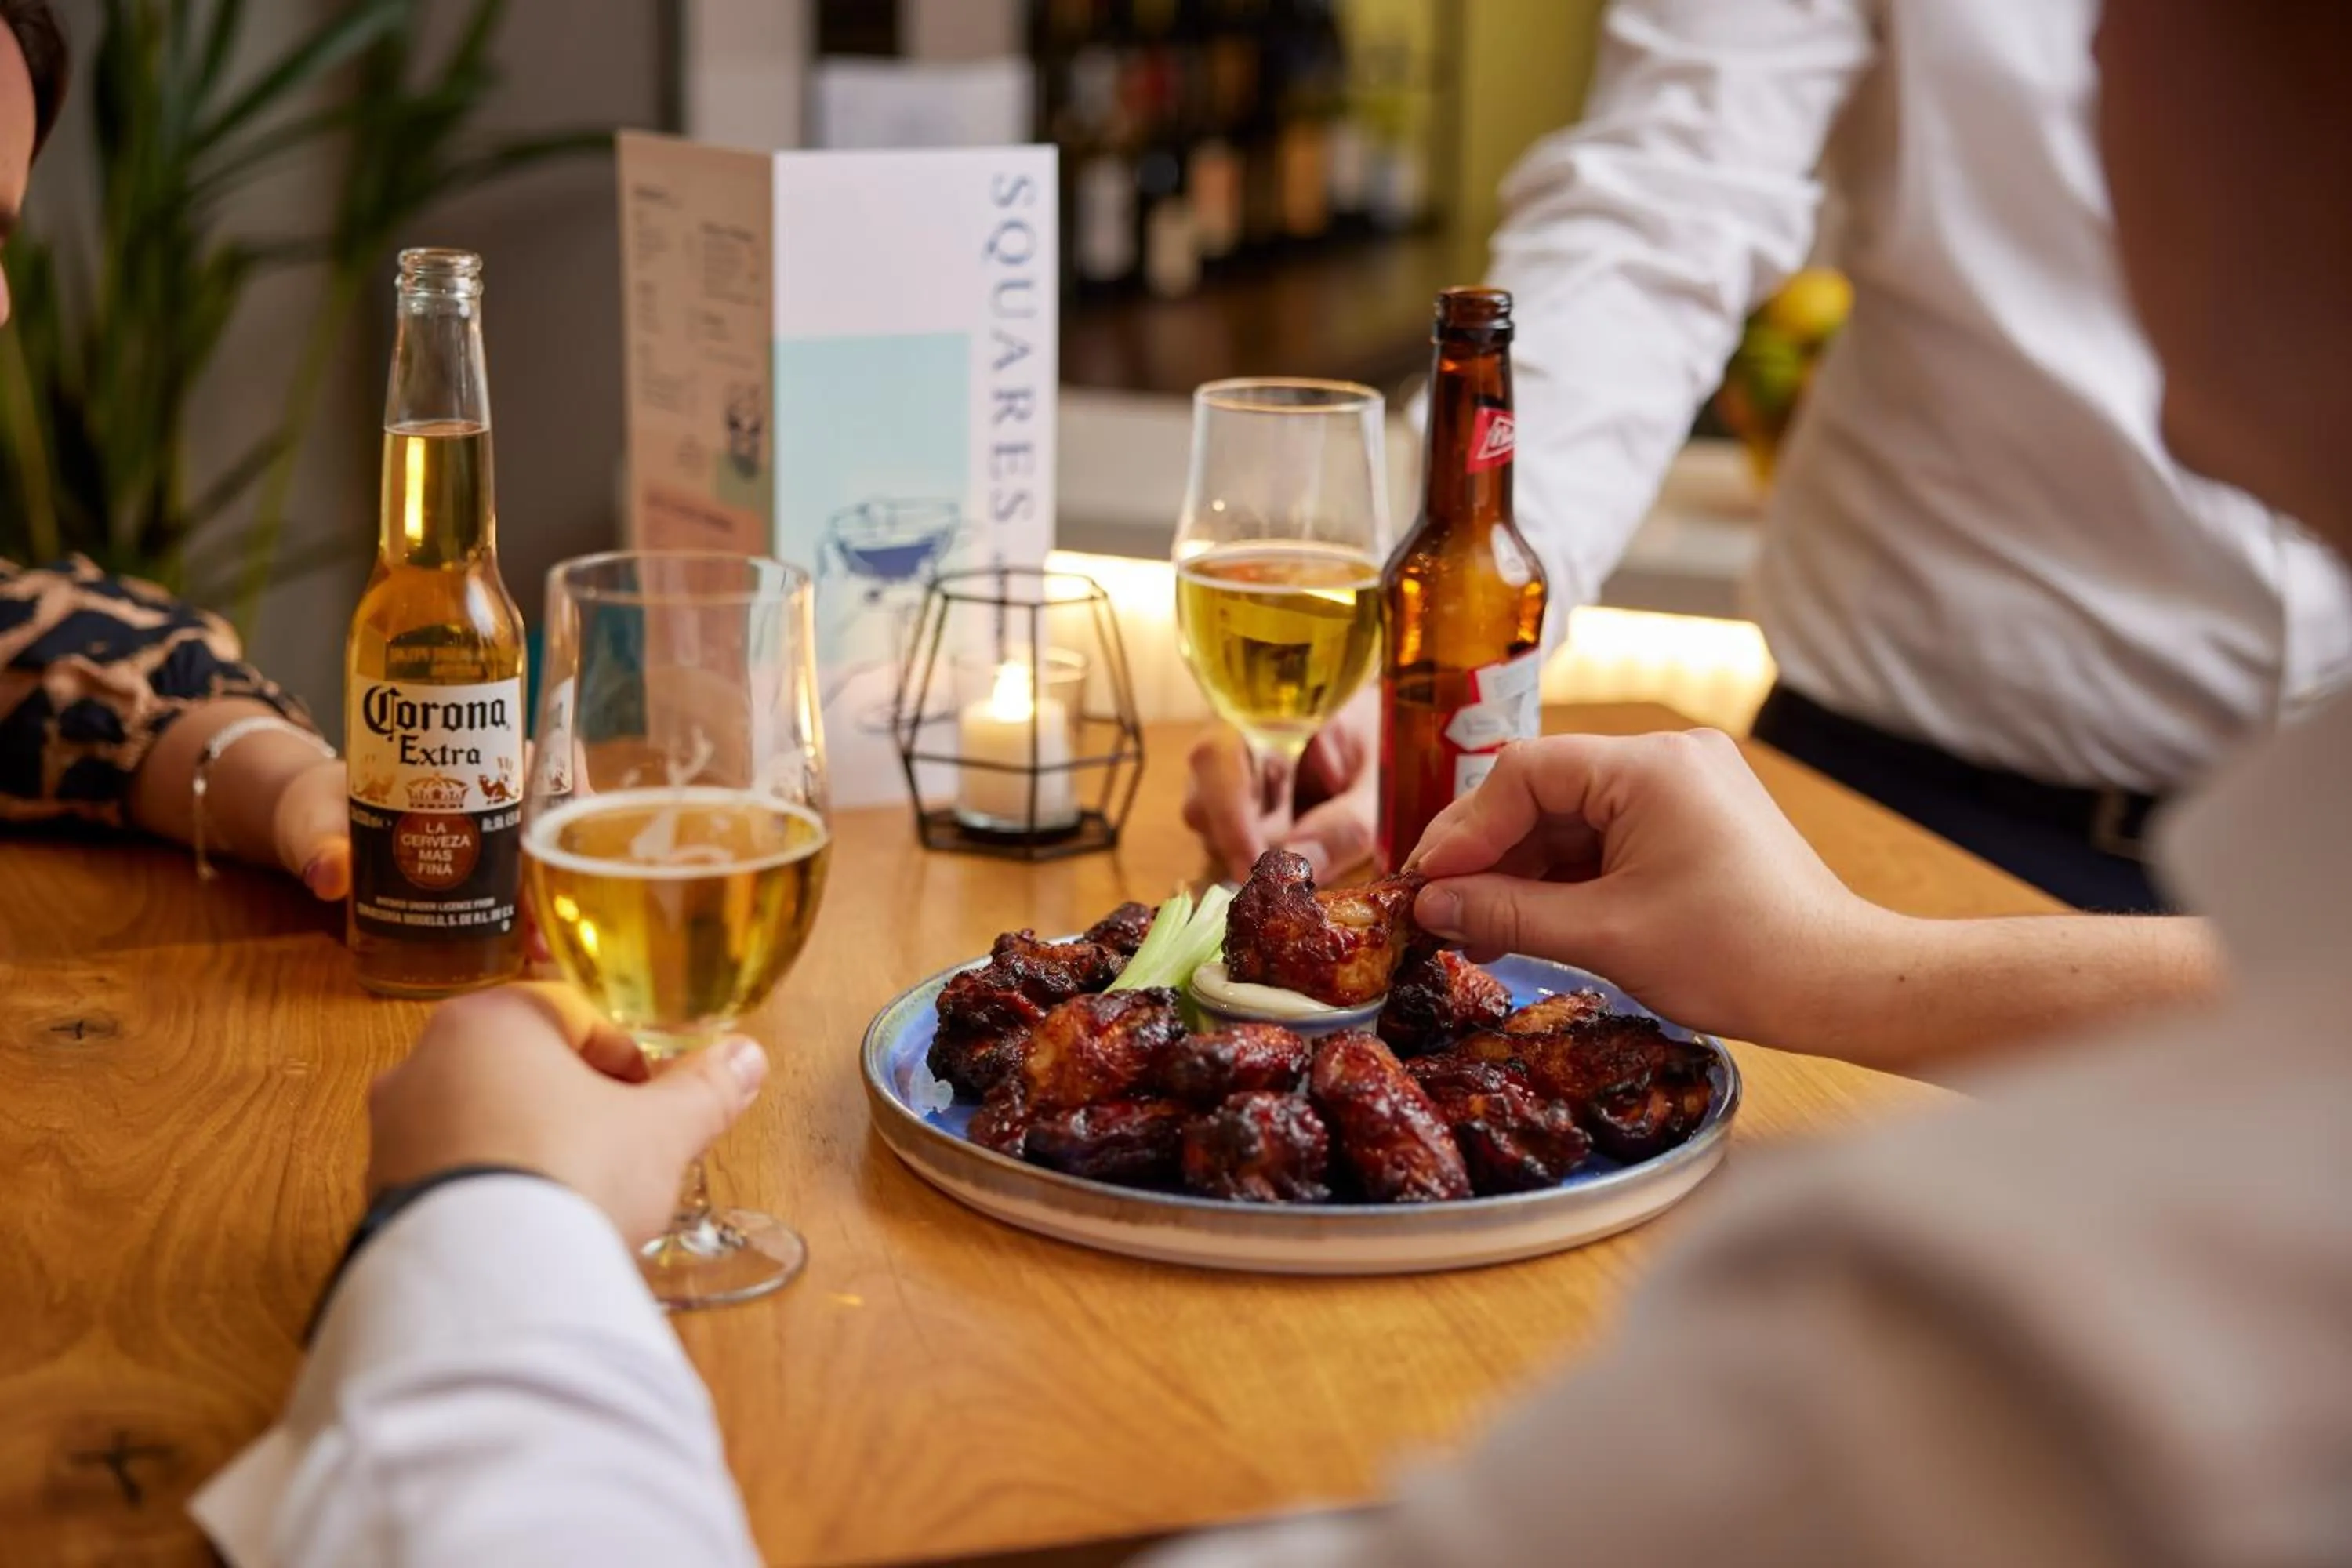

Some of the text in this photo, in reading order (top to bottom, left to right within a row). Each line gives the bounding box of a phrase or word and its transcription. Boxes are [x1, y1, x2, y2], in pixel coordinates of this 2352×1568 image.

[982, 172, 1037, 522] SQUARES
[363, 684, 506, 740] Corona
[399, 735, 481, 766] Extra
[426, 822, 447, 833] LA
[401, 834, 471, 848] CERVEZA
[419, 849, 452, 862] MAS
[418, 863, 453, 876] FINA
